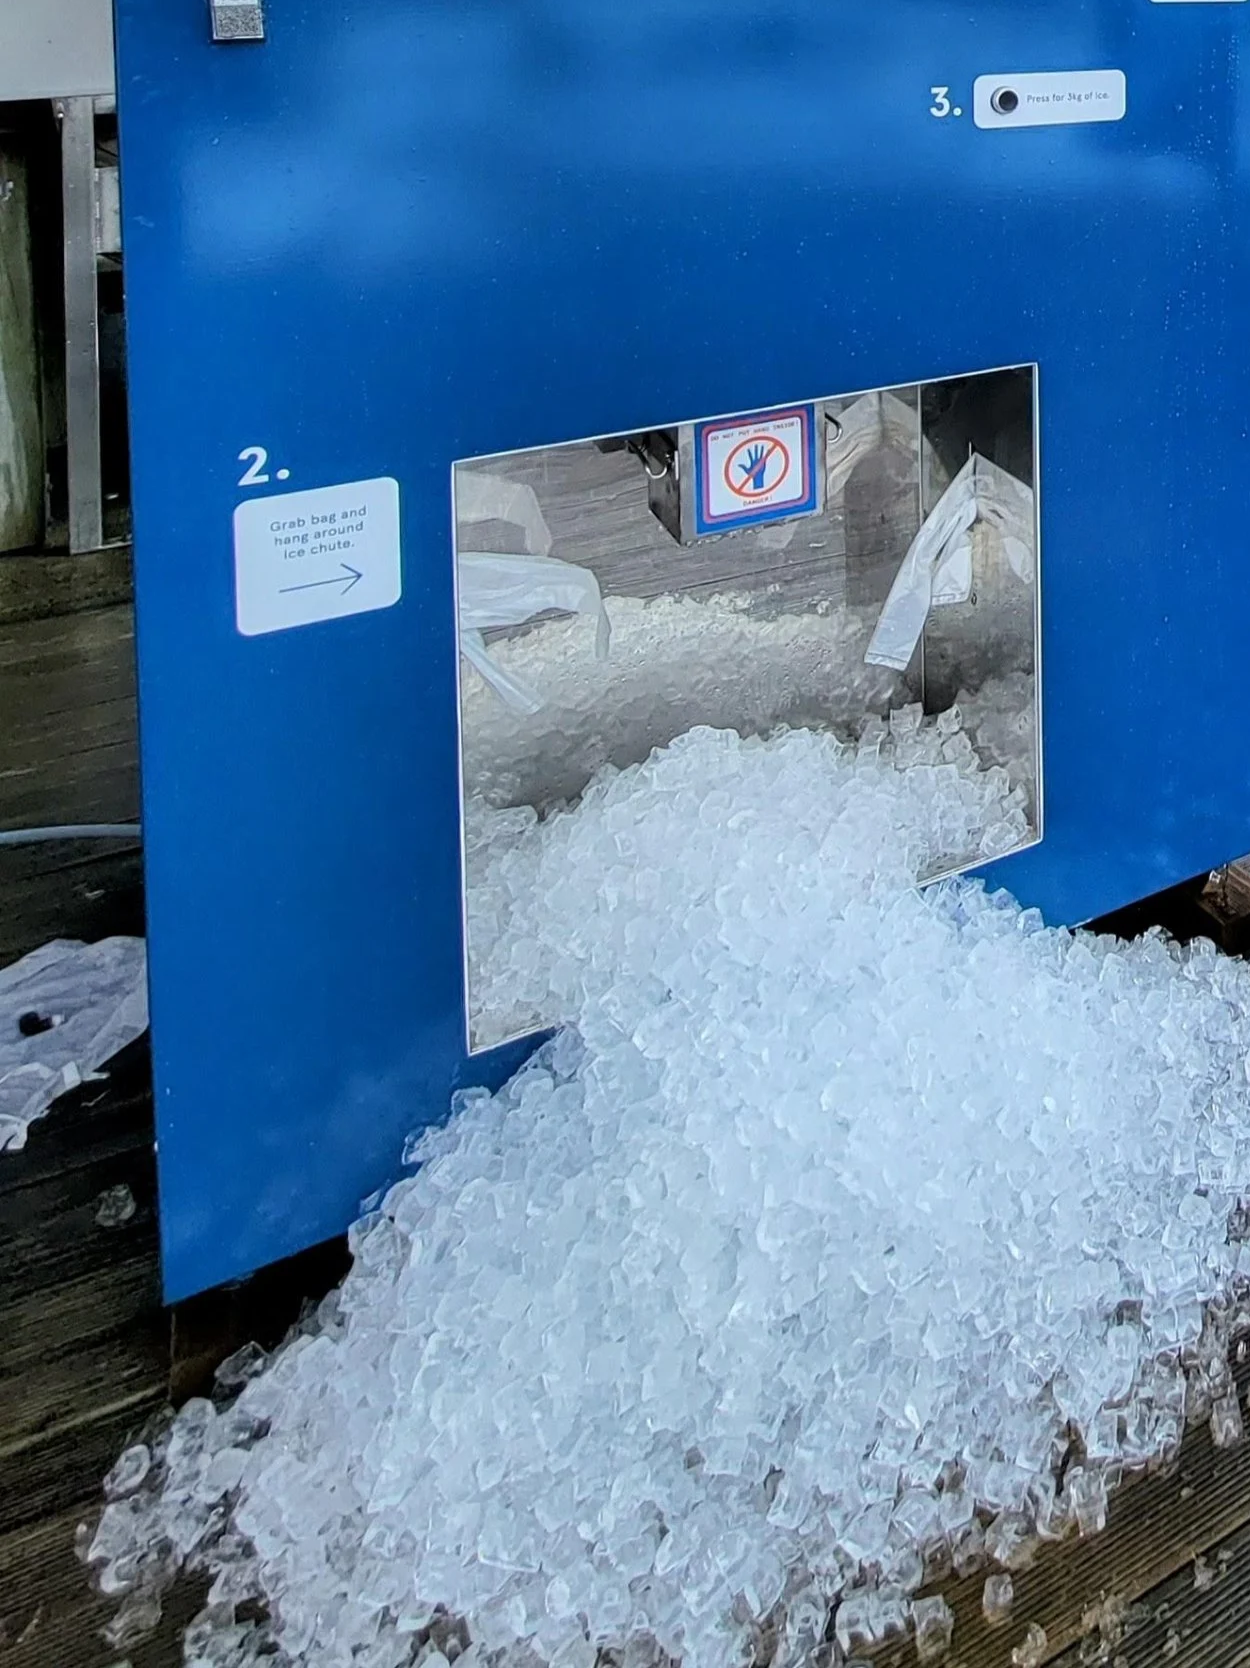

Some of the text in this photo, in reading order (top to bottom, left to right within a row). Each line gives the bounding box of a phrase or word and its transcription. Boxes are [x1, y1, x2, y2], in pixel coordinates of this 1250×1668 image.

[929, 85, 963, 118] 3.
[1026, 94, 1050, 104] Press
[1052, 93, 1065, 102] for
[1067, 92, 1083, 103] 3kg
[1084, 90, 1093, 100] of
[237, 446, 291, 487] 2.
[270, 505, 367, 533] Grab bag and
[274, 520, 364, 547] hang around
[310, 538, 355, 555] chute.
